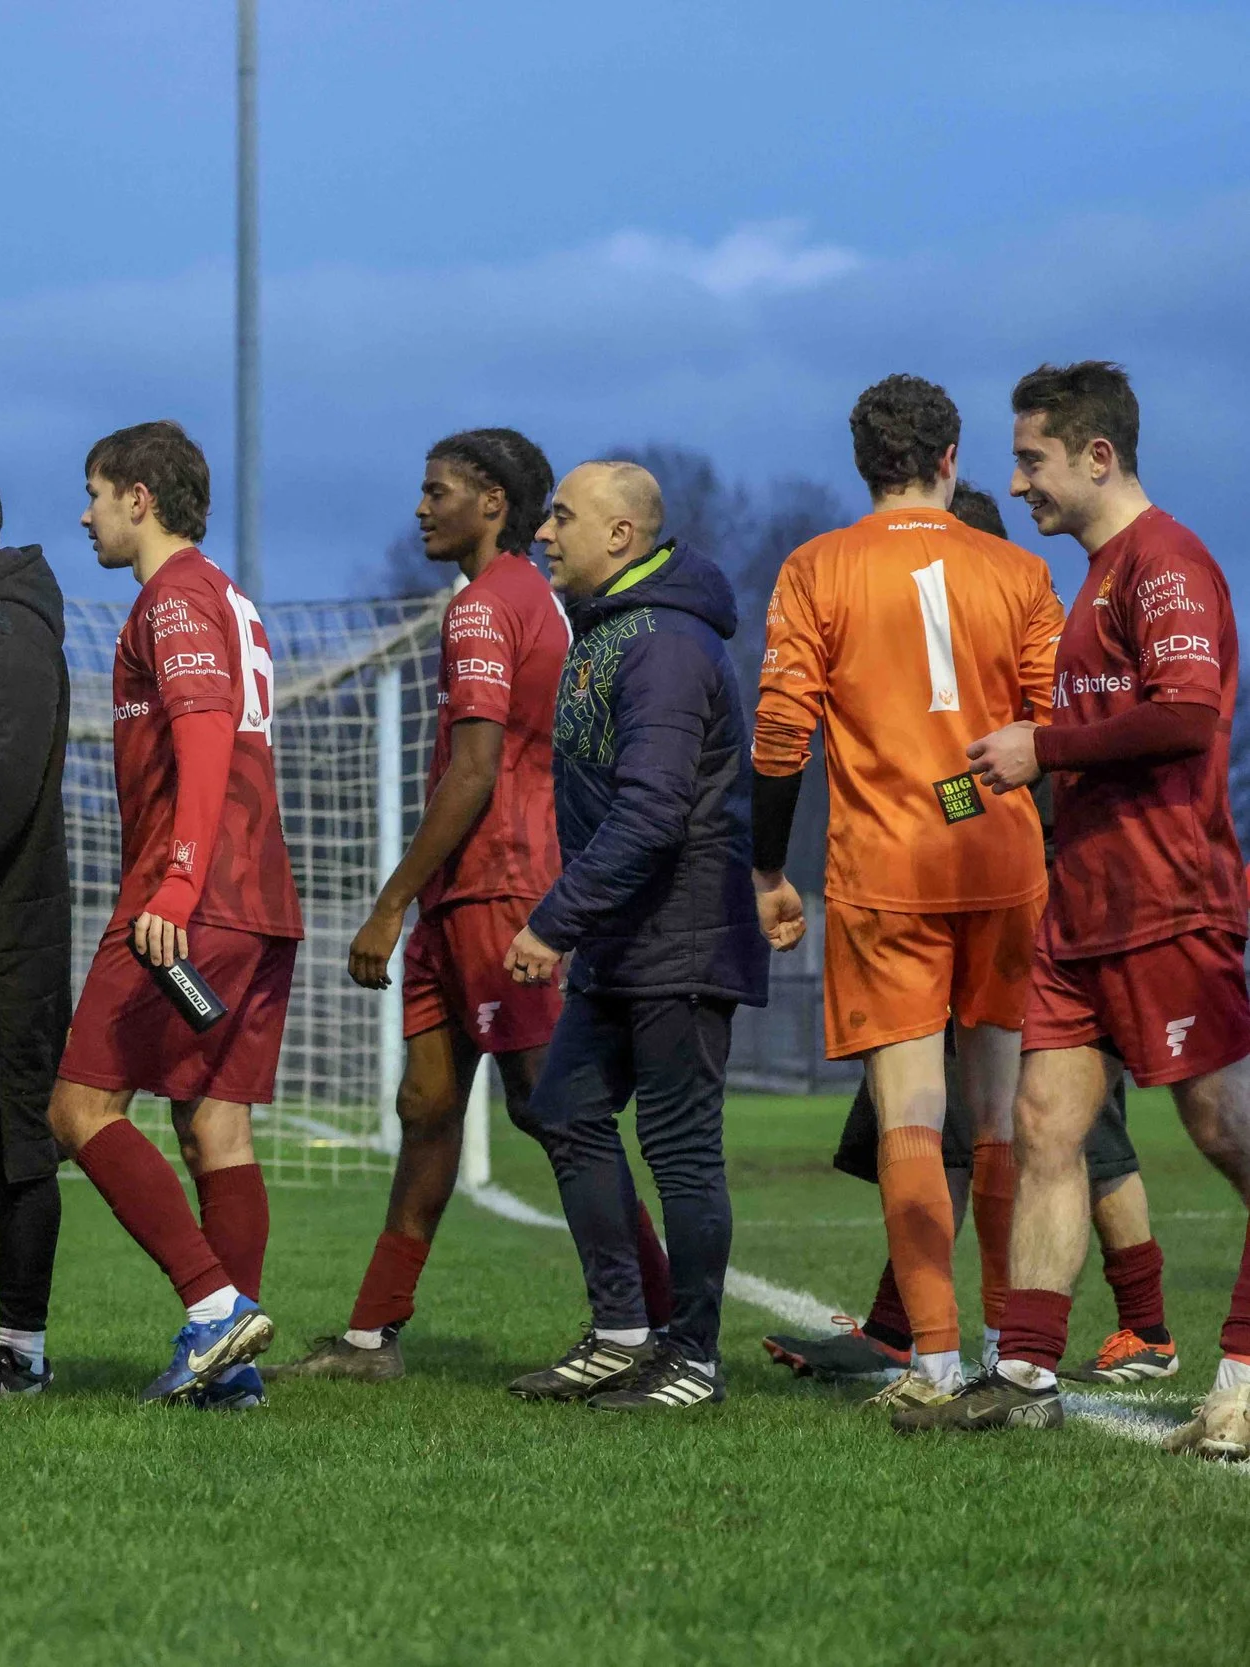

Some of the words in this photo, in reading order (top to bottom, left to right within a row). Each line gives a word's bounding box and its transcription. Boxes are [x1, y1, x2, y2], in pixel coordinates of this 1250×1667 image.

[888, 521, 932, 531] BALHAM
[1137, 570, 1186, 597] Charles
[151, 608, 187, 630] ussell
[154, 621, 208, 644] peechlys
[910, 559, 960, 712] 1
[1153, 634, 1210, 658] EDR
[164, 652, 215, 675] EDR
[457, 658, 504, 678] EDR
[942, 790, 969, 803] YELLOW
[943, 777, 972, 795] BIG
[945, 796, 972, 813] SELF
[949, 807, 976, 820] STORAGE
